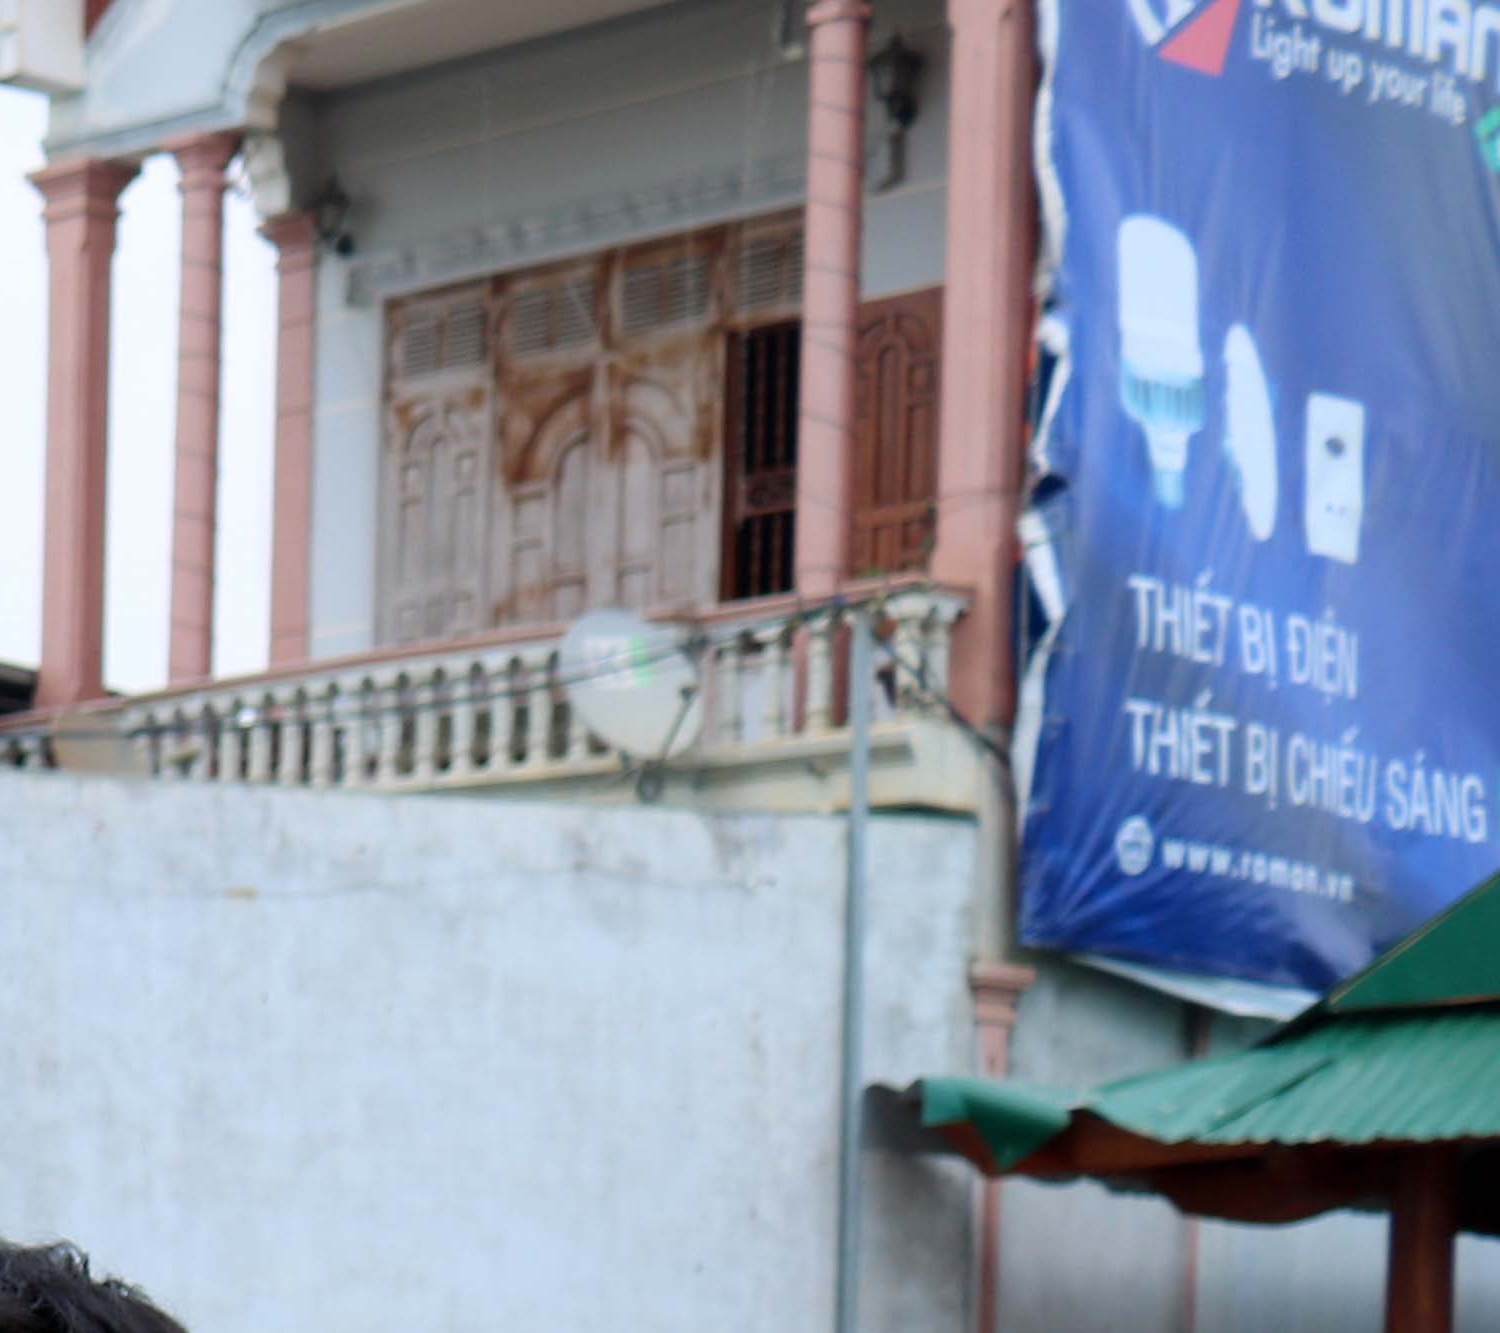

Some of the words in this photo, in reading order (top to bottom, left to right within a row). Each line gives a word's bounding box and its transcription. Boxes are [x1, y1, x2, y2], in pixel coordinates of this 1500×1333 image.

[1252, 0, 1500, 93] MAN
[1252, 12, 1321, 79] Light
[1327, 49, 1363, 95] up
[1369, 61, 1427, 107] your
[1430, 71, 1466, 126] life
[1127, 568, 1233, 667] THIẾT
[1238, 603, 1278, 691] BỊ
[1287, 606, 1358, 705] ĐIỆN
[1124, 687, 1237, 788] THIẾT
[1246, 721, 1278, 812] BỊ
[1287, 725, 1377, 823] CHIẾU
[1386, 748, 1488, 843] SÁNG
